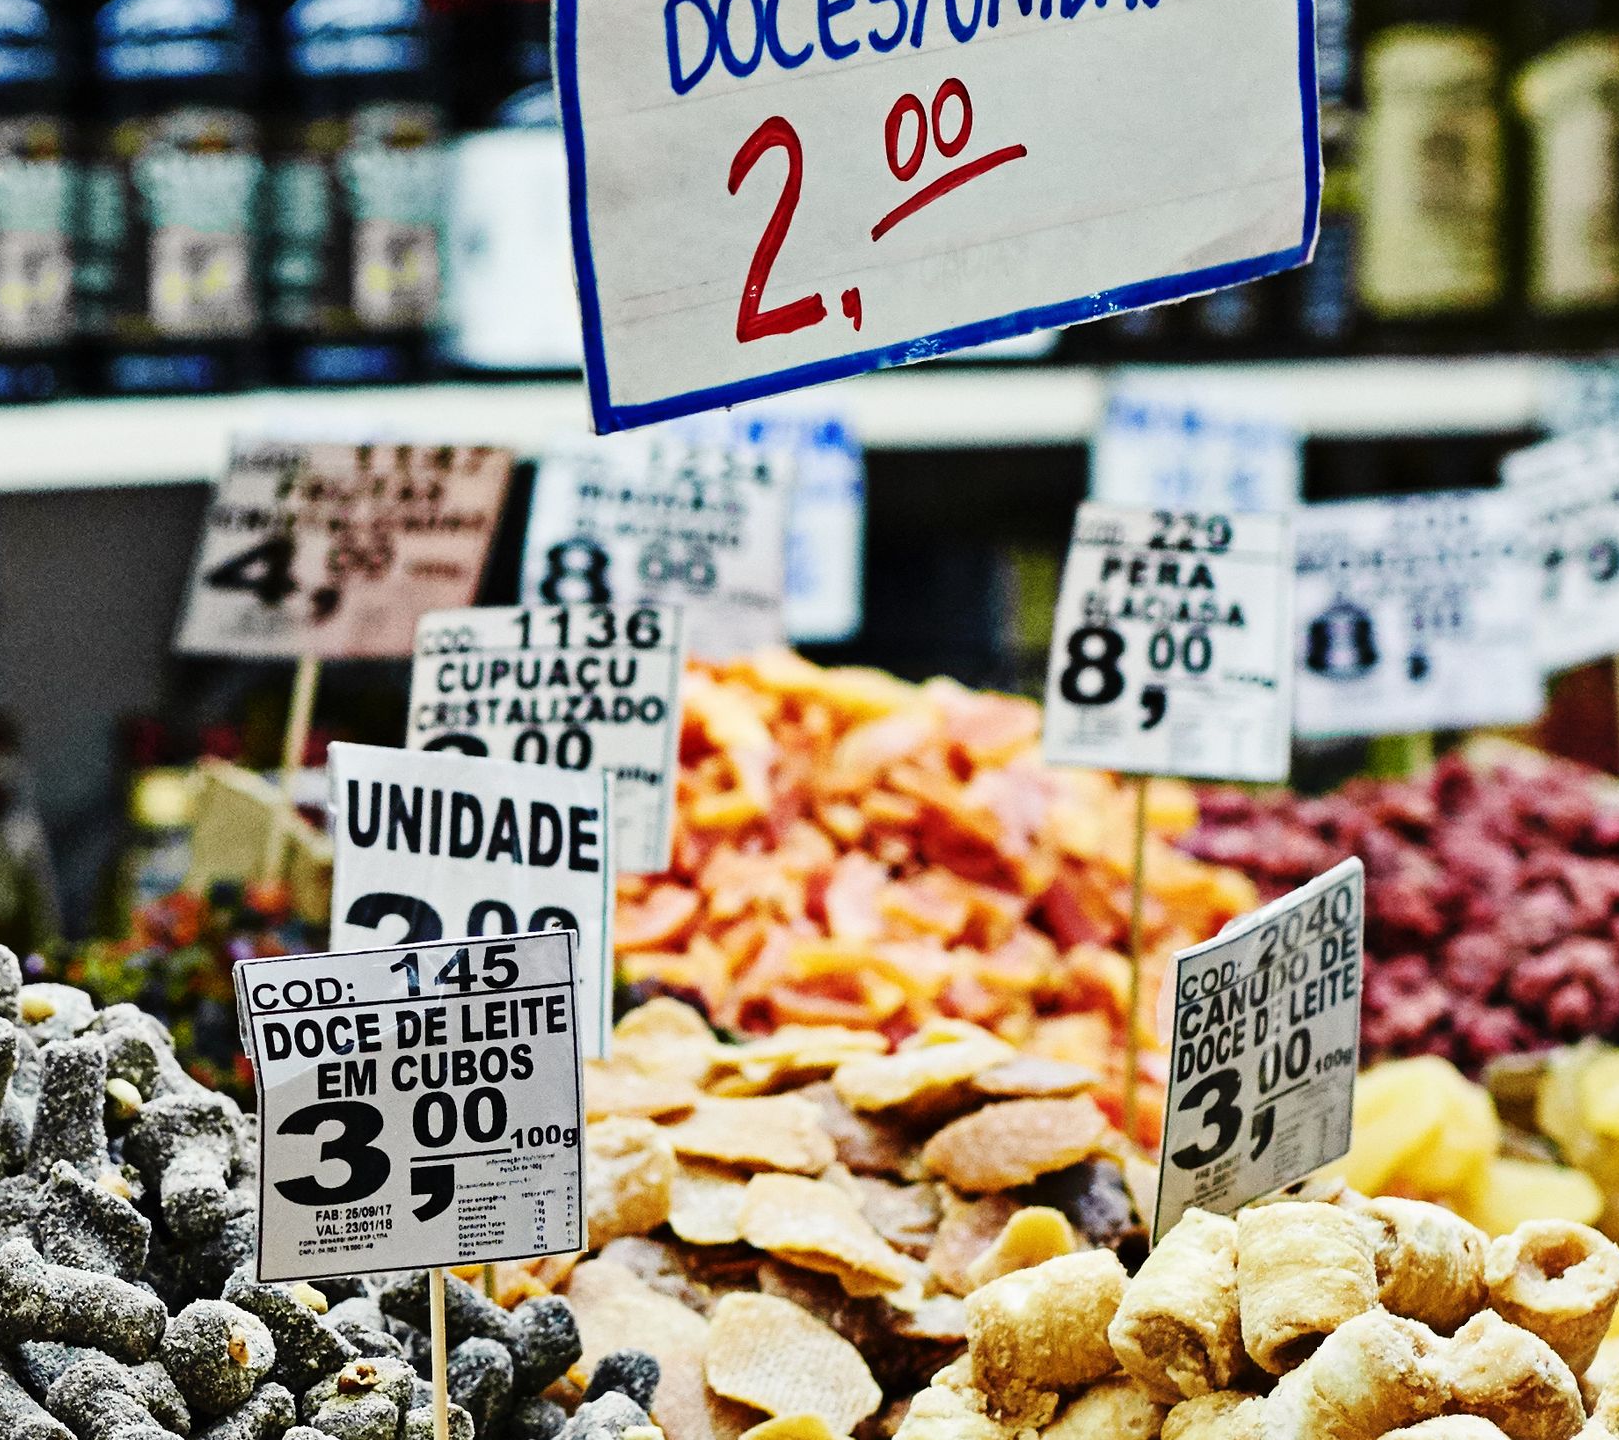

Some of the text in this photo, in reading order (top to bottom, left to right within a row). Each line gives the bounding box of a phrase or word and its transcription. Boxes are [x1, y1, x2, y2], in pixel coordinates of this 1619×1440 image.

[514, 610, 661, 650] 1136
[437, 657, 637, 694] CUPUAÇU
[347, 779, 599, 873] UNIDADE
[252, 944, 520, 1011] COD: 145
[1179, 928, 1357, 1042] CANUDO DE
[263, 994, 567, 1061] DOCE DE LEITE
[1176, 1021, 1246, 1084] DOCE
[1289, 960, 1357, 1027] LEITE
[317, 1044, 534, 1100] EM CUBOS
[509, 1124, 579, 1149] 100g
[316, 1209, 343, 1222] FAB:
[316, 1218, 393, 1237] VAL: 23/01/18
